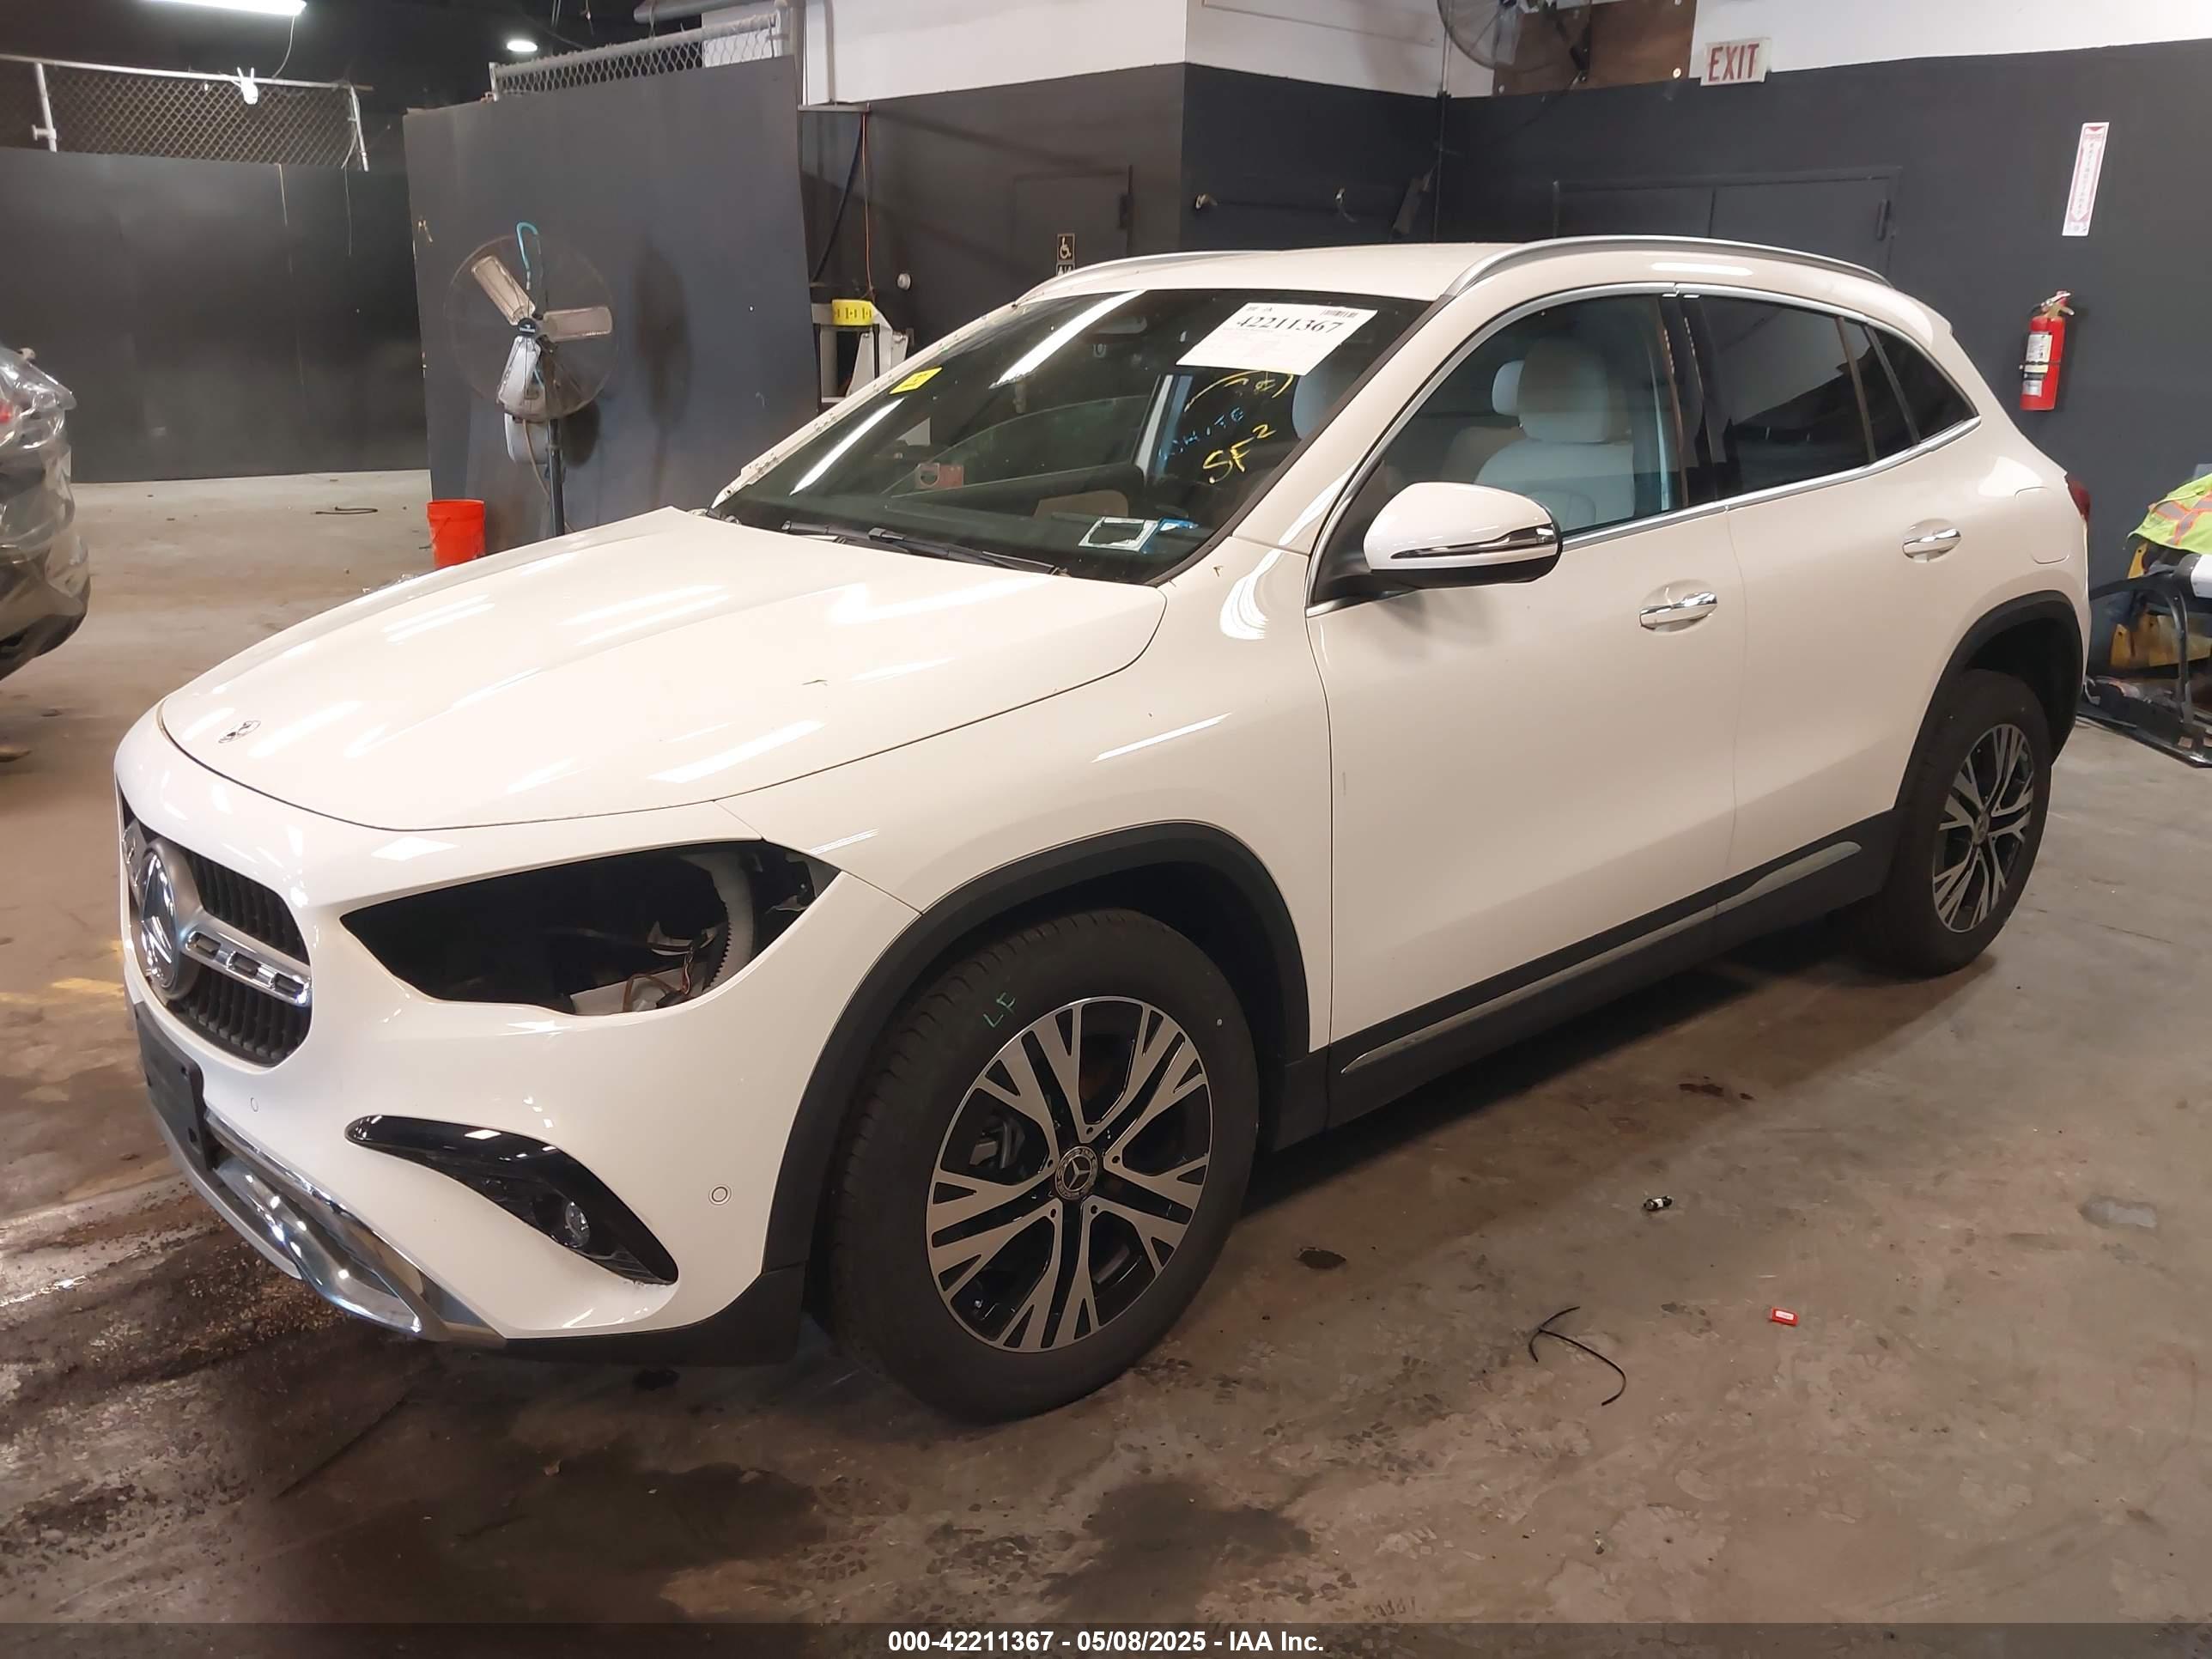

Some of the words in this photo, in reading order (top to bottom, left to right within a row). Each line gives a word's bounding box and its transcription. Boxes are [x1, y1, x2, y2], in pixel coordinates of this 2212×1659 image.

[1708, 43, 1760, 82] EXIT
[1237, 316, 1345, 333] 42211367
[982, 992, 1017, 1028] LF
